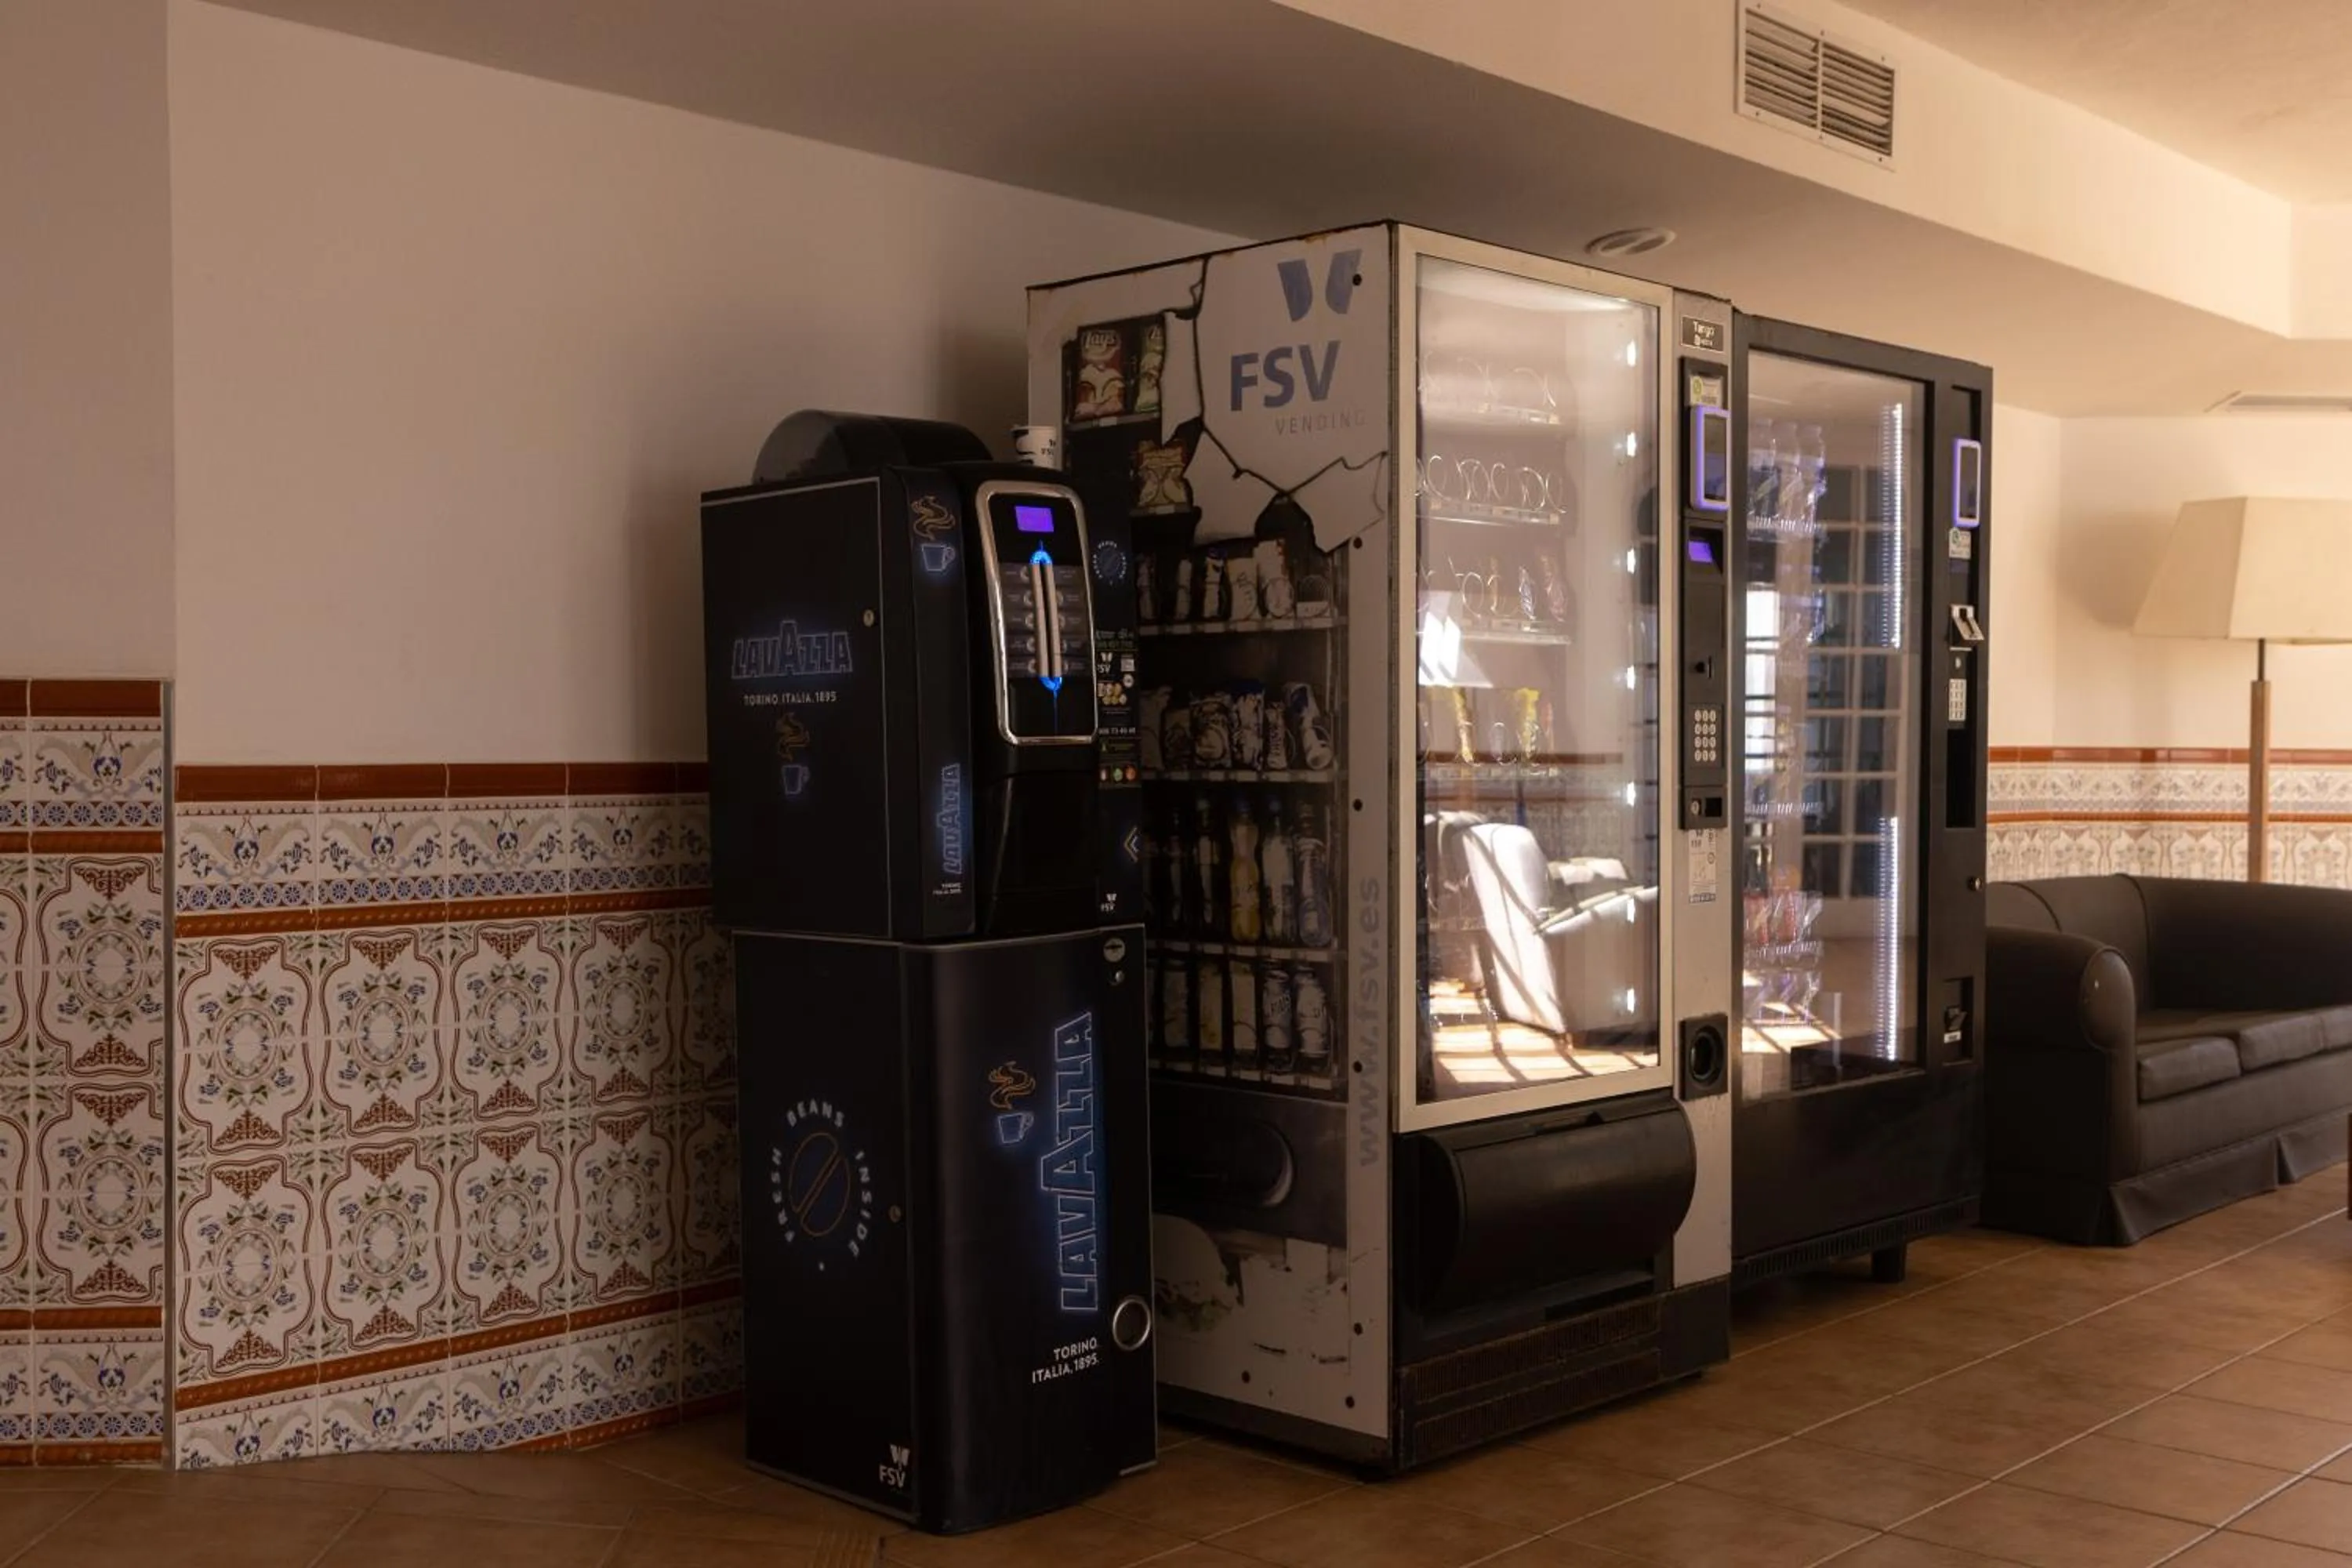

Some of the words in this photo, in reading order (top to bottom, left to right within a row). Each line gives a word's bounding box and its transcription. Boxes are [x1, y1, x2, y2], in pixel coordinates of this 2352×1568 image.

[1230, 339, 1341, 412] FSV
[1275, 408, 1368, 435] VENDING
[730, 619, 854, 680] LAVAZZA
[936, 763, 963, 875] LAVAZZA
[771, 1147, 796, 1243] FRESH
[786, 1098, 844, 1127] BEANS
[848, 1149, 873, 1261] INSIDE
[1040, 1011, 1098, 1311] LAVAZZA
[1054, 1336, 1098, 1362] TORINO
[879, 1464, 906, 1489] FSV
